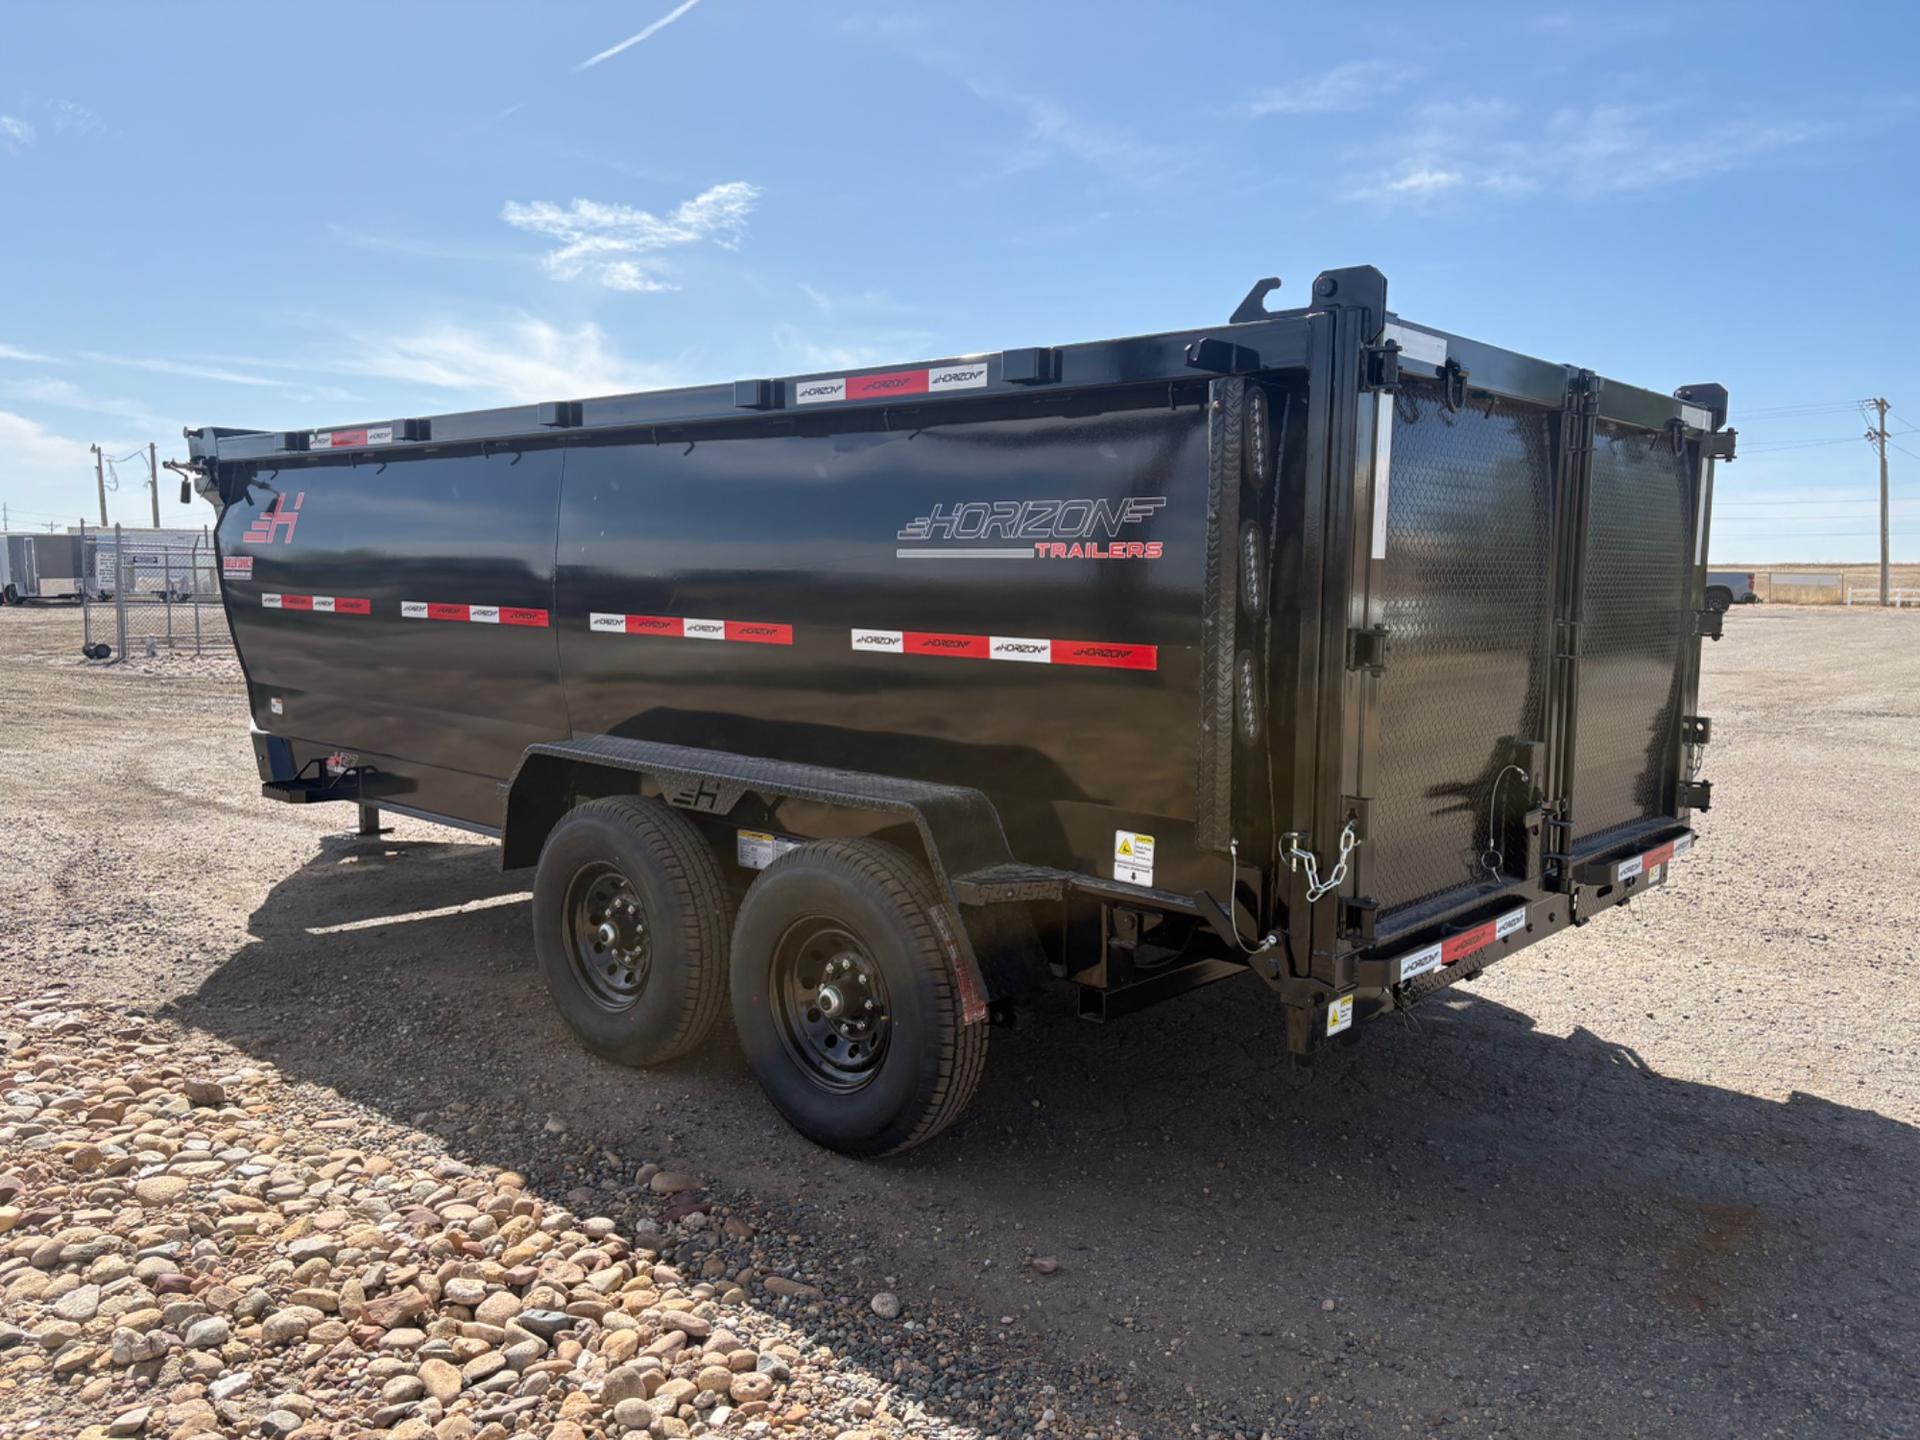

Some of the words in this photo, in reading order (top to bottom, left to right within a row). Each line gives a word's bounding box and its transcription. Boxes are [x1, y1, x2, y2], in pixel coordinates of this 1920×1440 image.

[931, 370, 985, 384] HORIZON
[897, 496, 1166, 540] HORIZON
[1035, 541, 1163, 560] TRAILERS
[856, 635, 901, 645] HORIZON
[922, 638, 971, 649] HORIZON
[994, 642, 1048, 654] HORIZON
[1073, 648, 1134, 660] HORIZON
